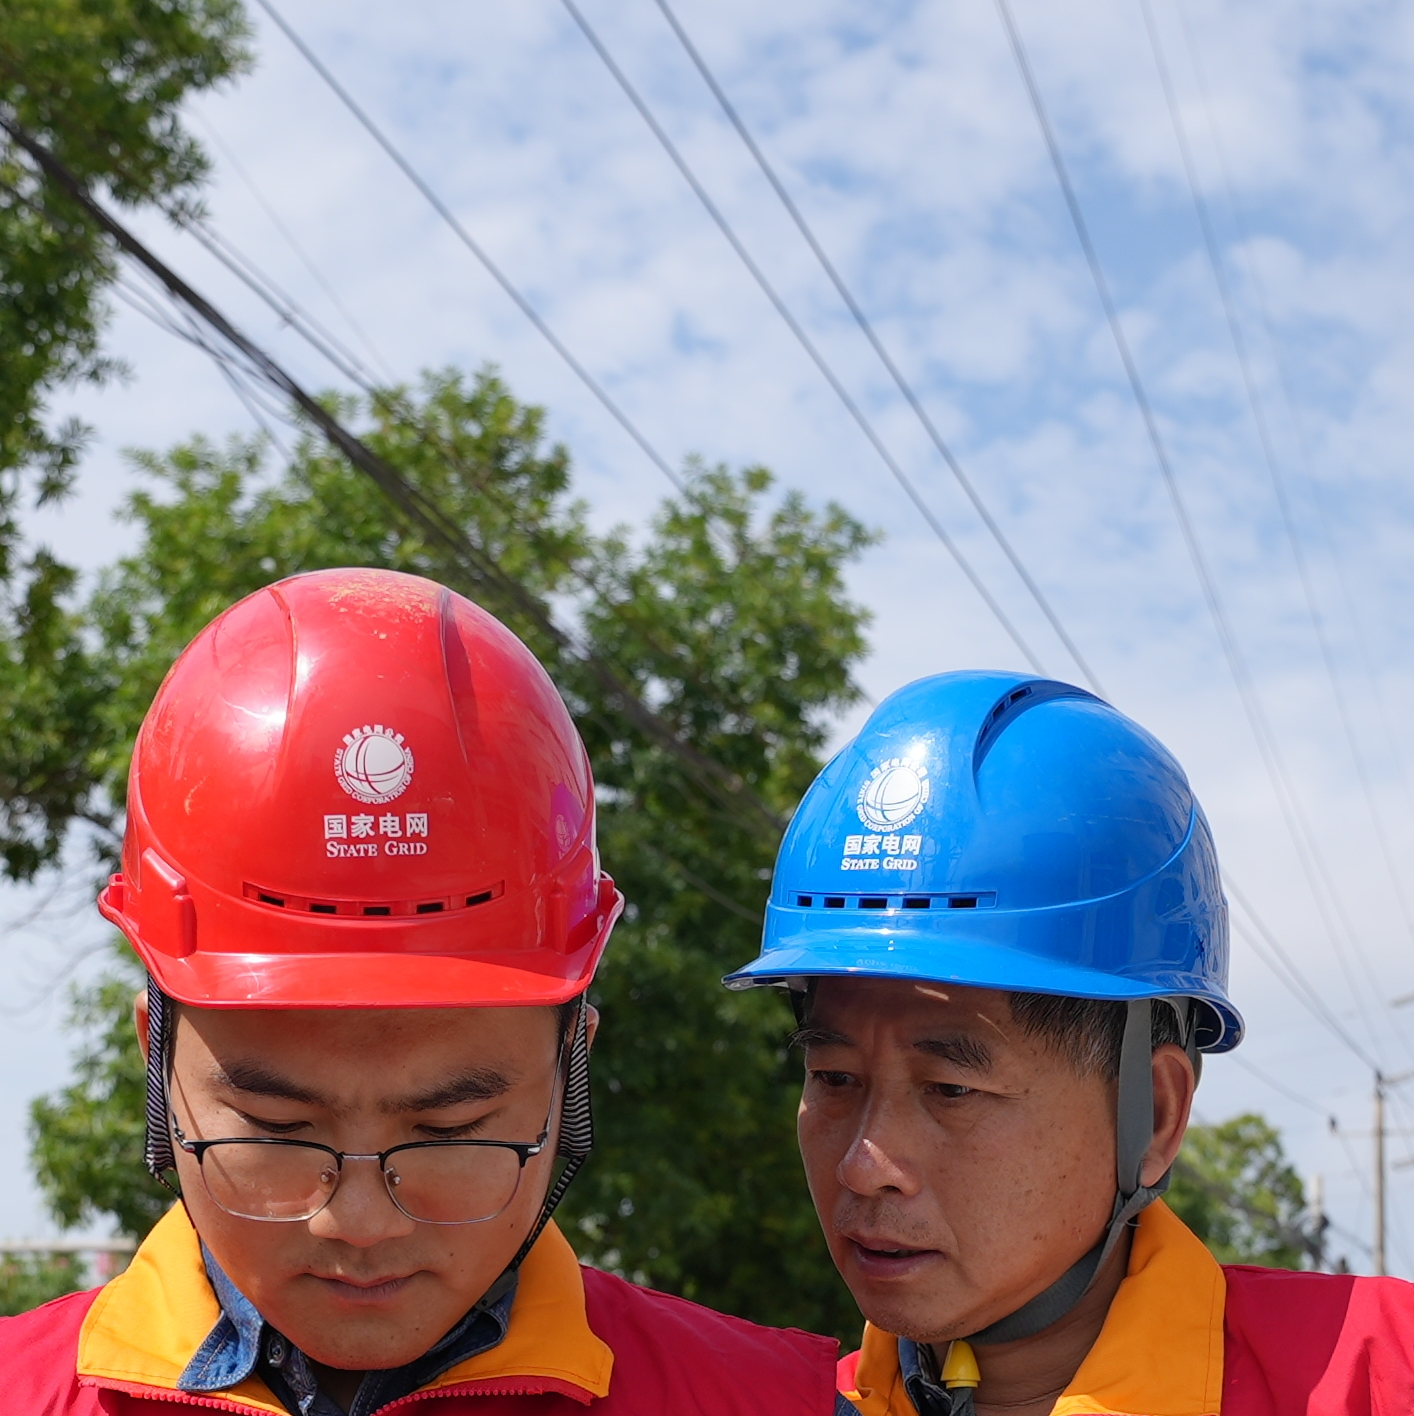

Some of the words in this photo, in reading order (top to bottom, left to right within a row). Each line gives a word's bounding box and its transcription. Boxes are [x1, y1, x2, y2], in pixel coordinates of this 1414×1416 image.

[323, 812, 428, 839] 国家电网
[326, 841, 378, 858] STATE
[384, 841, 428, 856] GRID
[843, 834, 922, 856] 国家电网
[841, 857, 879, 871] STATE
[882, 856, 918, 871] GRID
